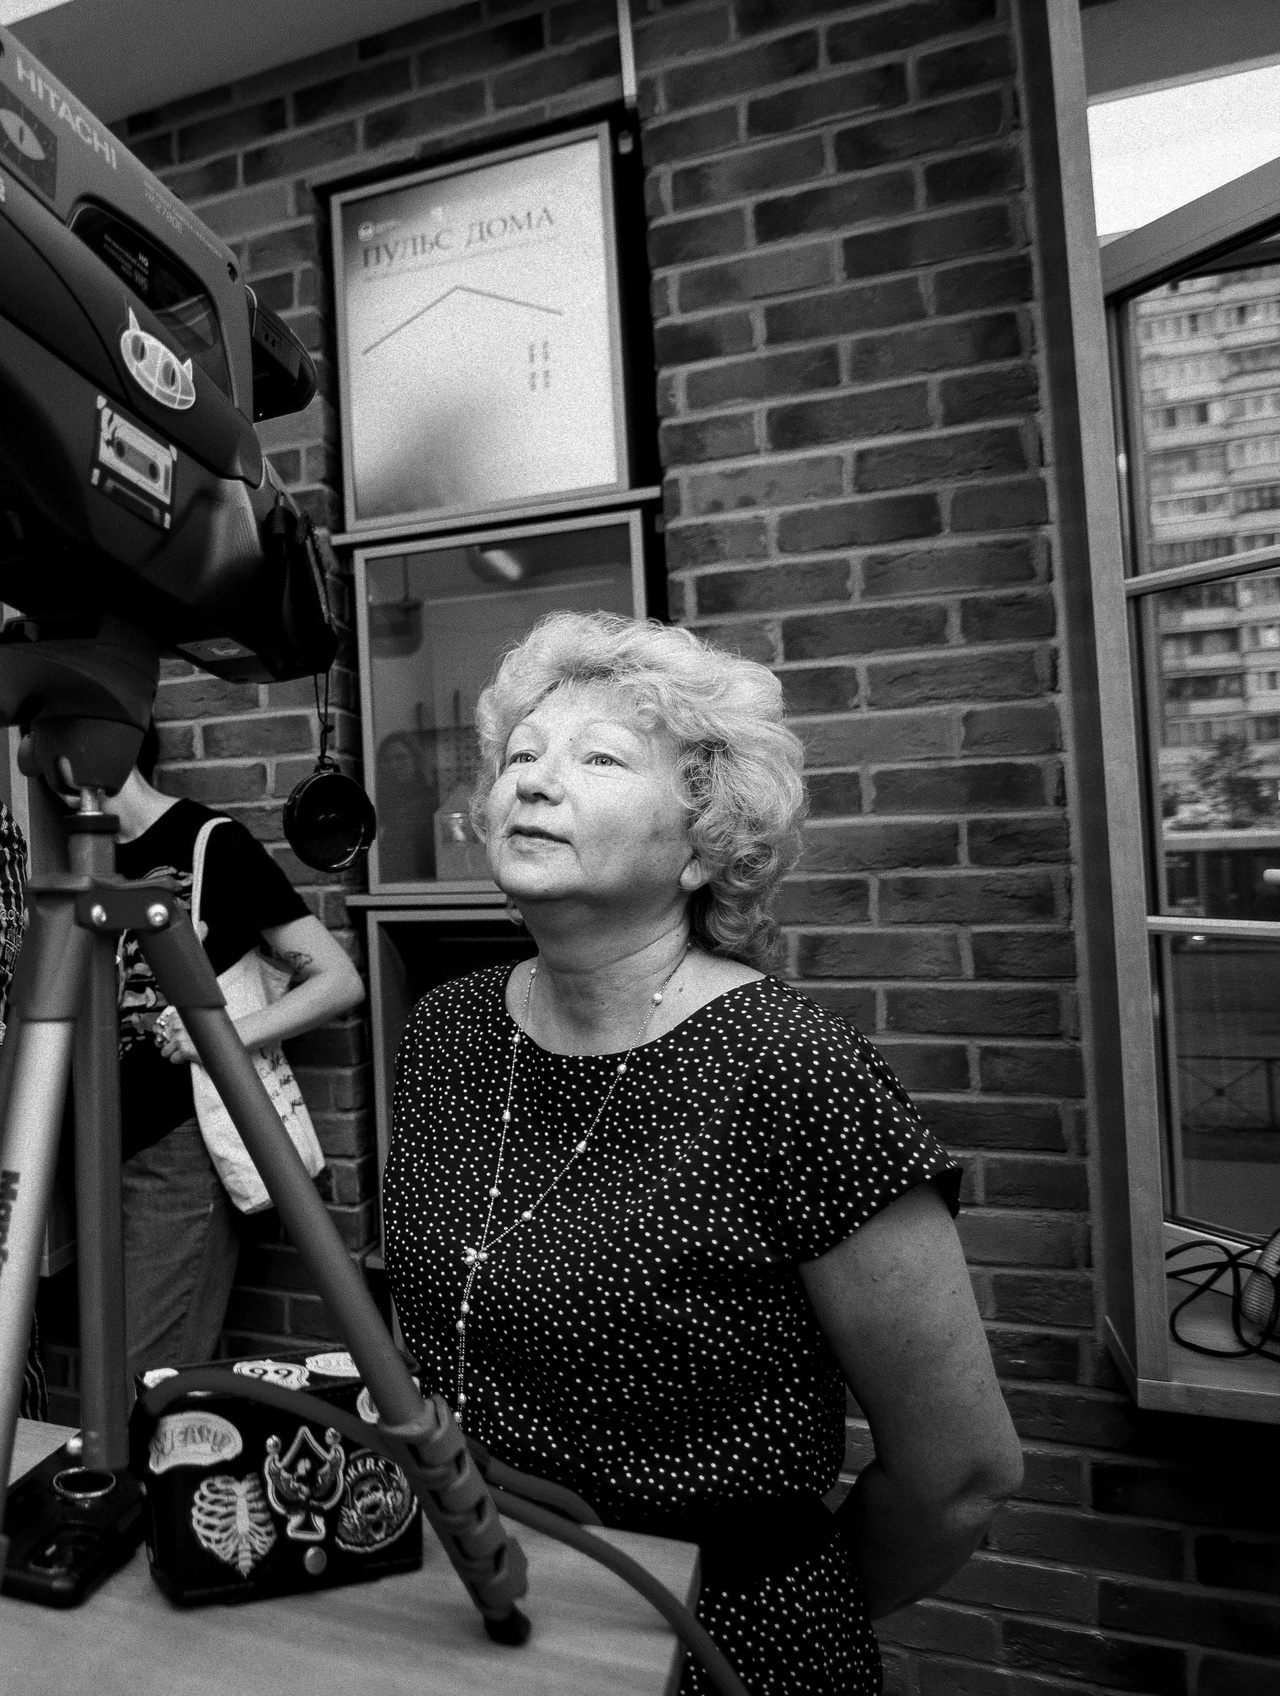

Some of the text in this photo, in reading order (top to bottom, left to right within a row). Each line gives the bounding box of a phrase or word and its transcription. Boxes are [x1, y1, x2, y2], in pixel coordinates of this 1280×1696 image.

[16, 56, 117, 170] HITACHI
[362, 228, 454, 268] ПУЛЬС
[464, 207, 554, 249] ДОМА
